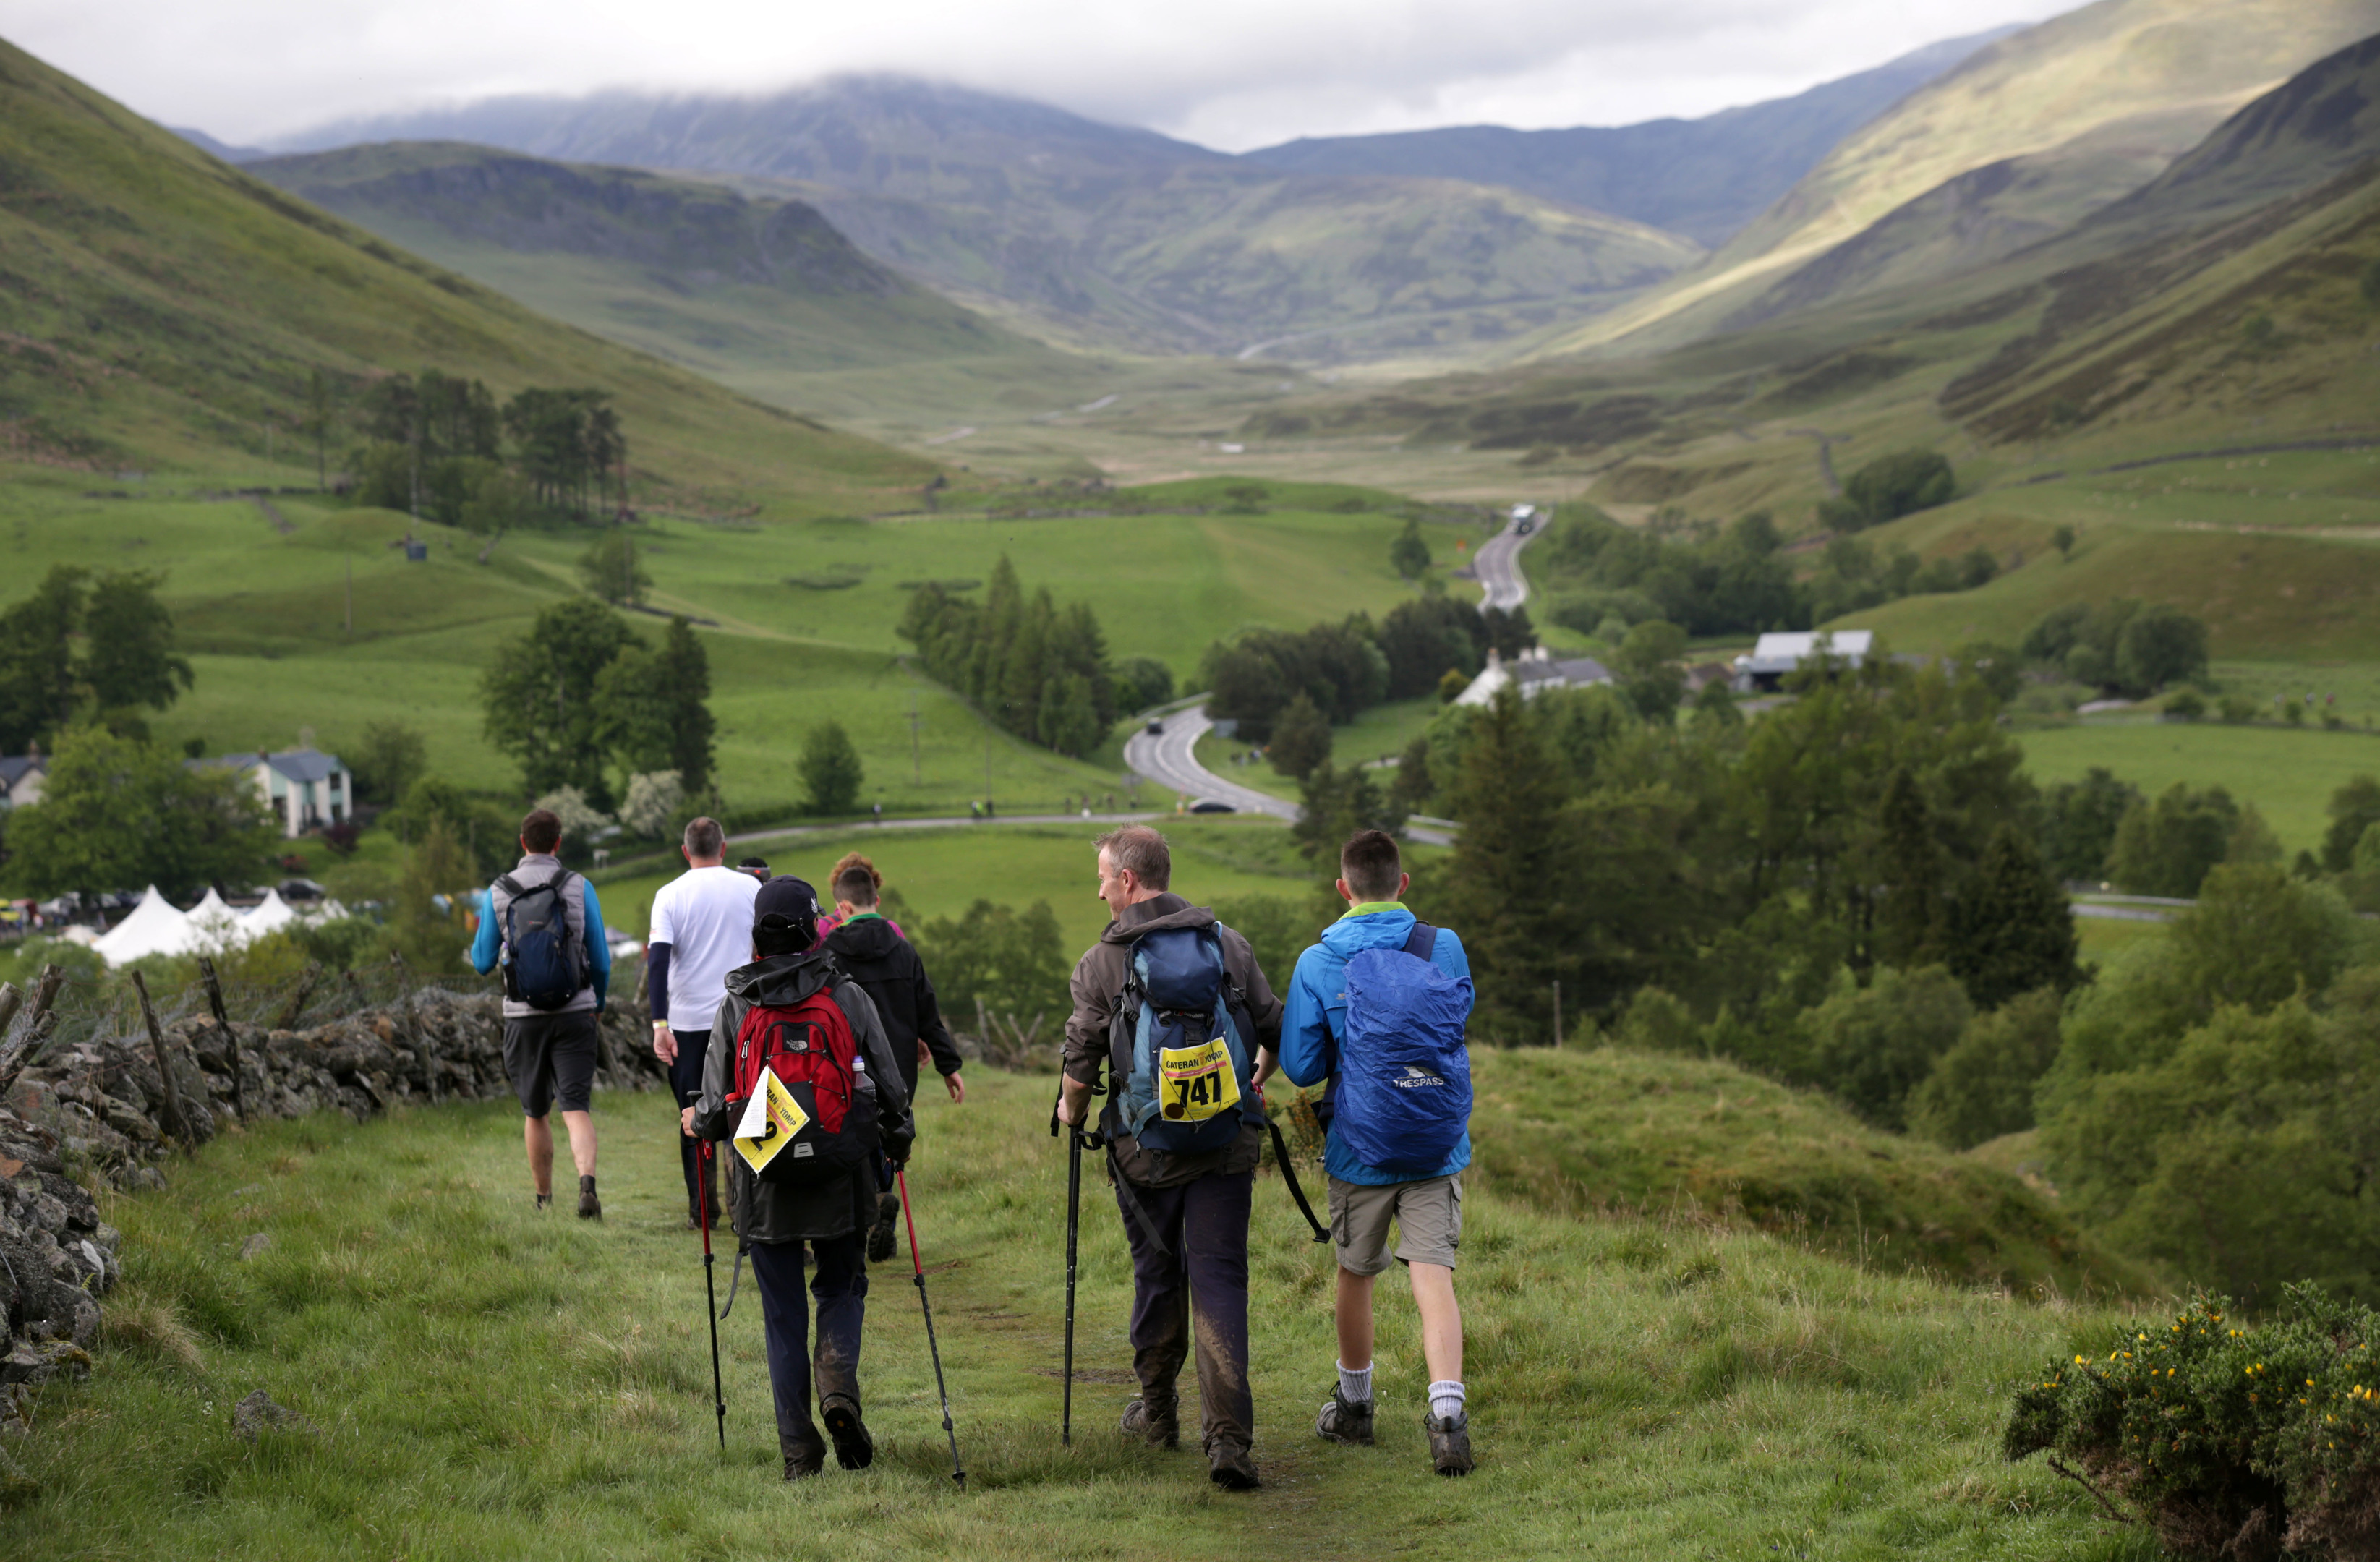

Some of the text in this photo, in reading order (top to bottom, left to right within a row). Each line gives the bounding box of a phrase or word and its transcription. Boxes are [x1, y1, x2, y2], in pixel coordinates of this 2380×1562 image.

[1166, 1059, 1199, 1070] CATERAN
[1174, 1071, 1221, 1108] 747
[1393, 1077, 1444, 1088] TRESPASS
[767, 1087, 778, 1105] RAN
[780, 1107, 796, 1126] YOMP
